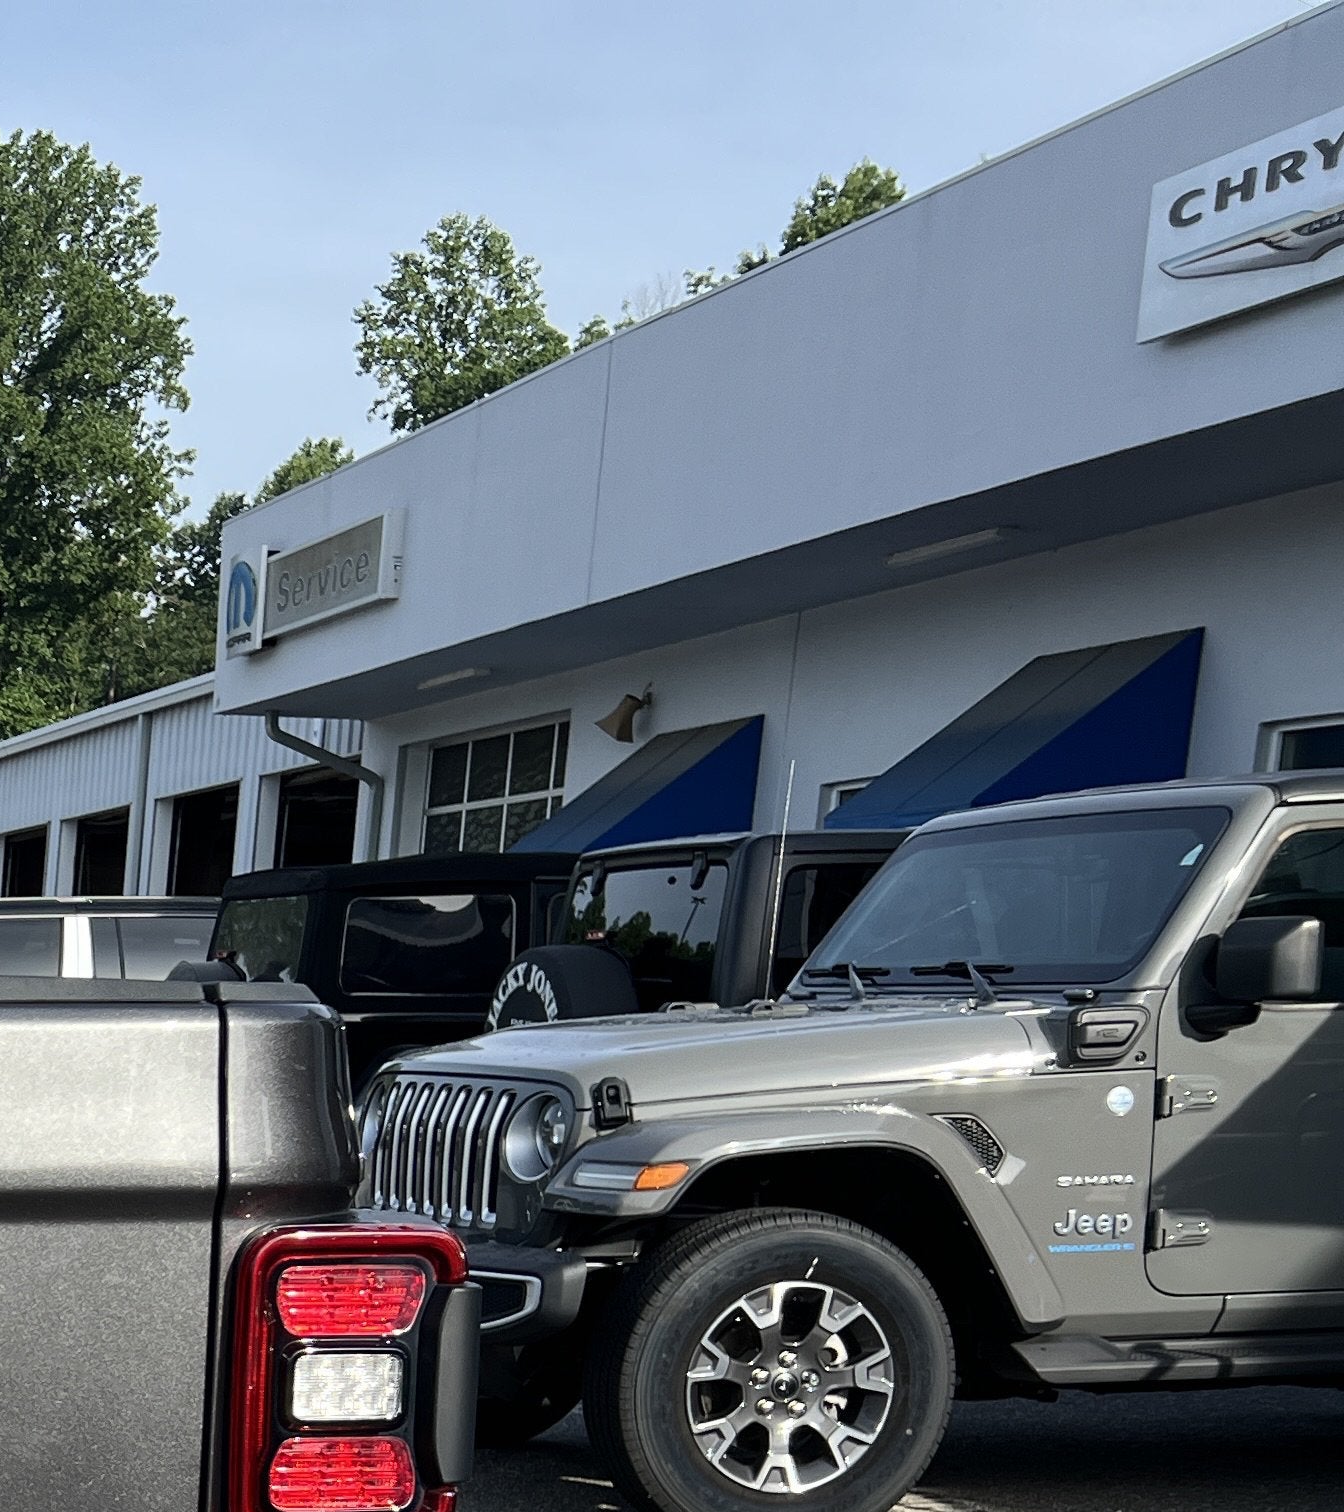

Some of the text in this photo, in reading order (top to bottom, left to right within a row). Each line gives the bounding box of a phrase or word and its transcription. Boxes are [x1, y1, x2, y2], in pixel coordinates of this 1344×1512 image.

[276, 551, 370, 613] Service
[526, 963, 559, 1024] JONE
[1057, 1174, 1136, 1188] SAHARA
[1053, 1208, 1134, 1239] Jeep
